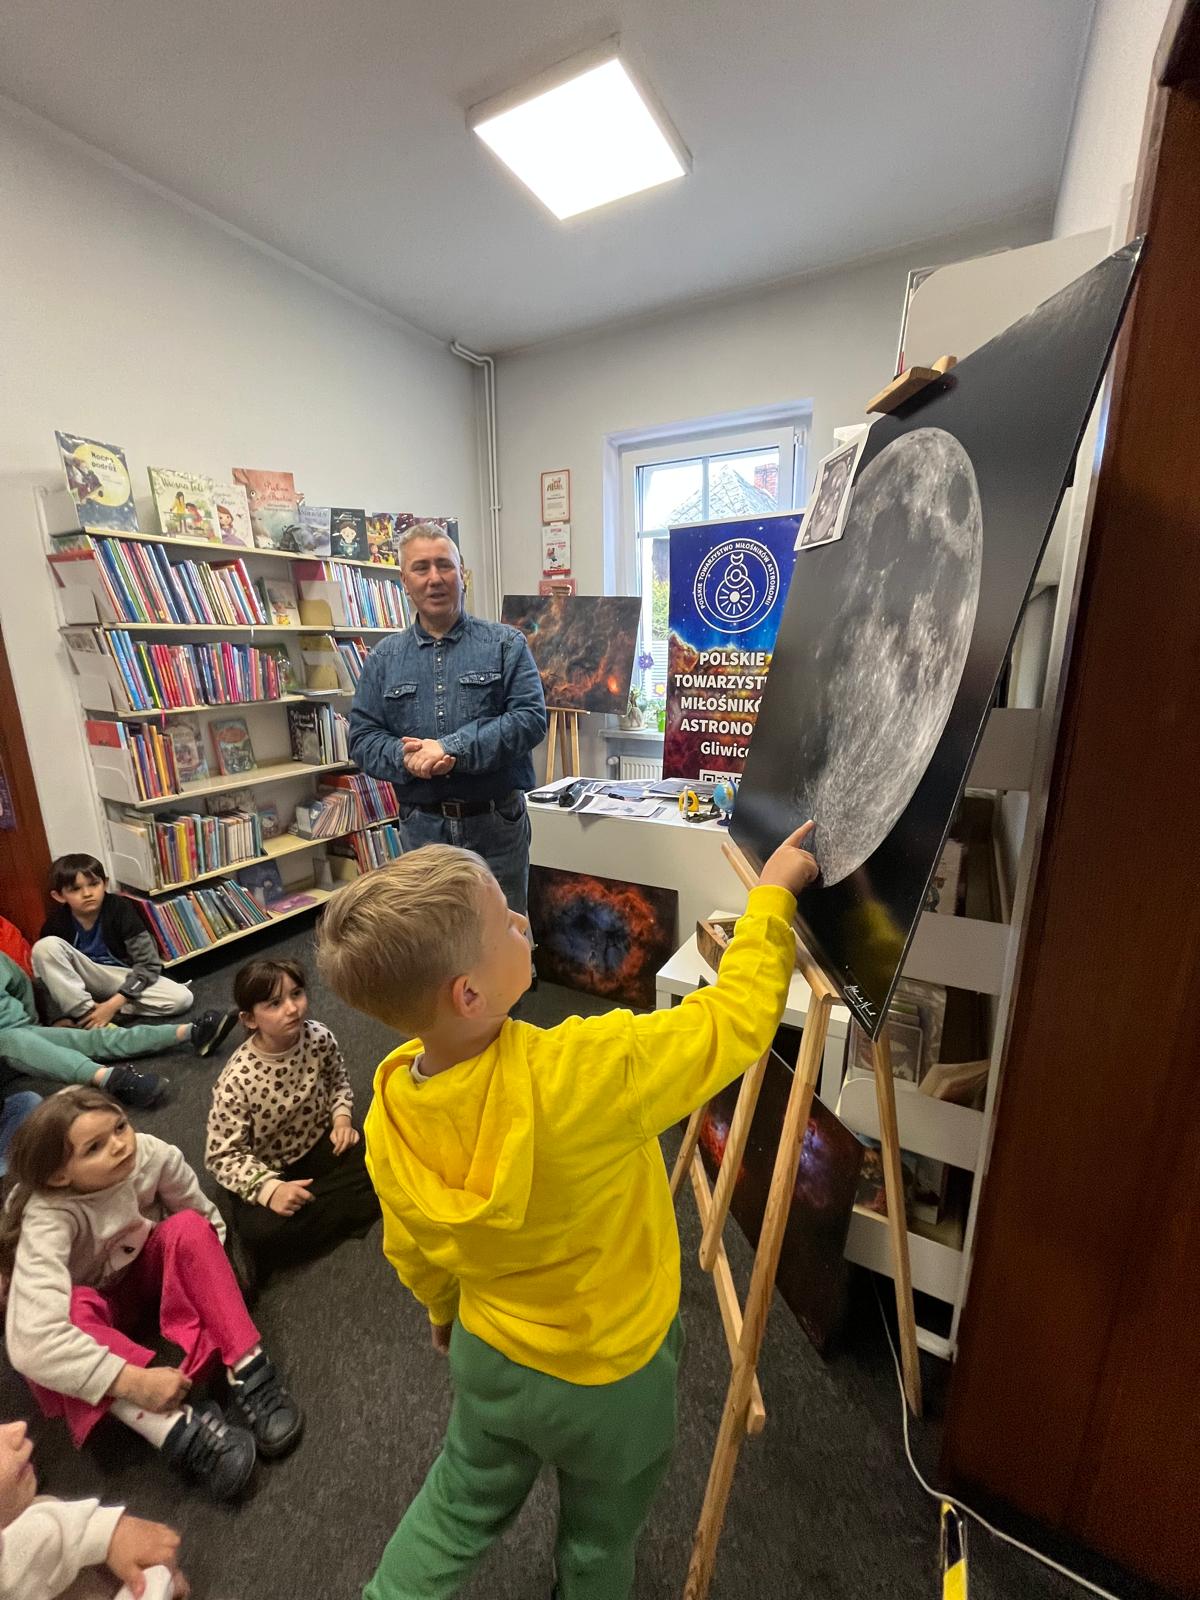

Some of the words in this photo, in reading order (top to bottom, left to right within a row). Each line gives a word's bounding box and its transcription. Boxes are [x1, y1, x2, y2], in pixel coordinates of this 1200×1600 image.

[735, 541, 770, 563] MIŁOŚNIKÓW
[699, 544, 734, 581] TOWARZYSTWO
[764, 563, 776, 606] ASTRONOMII
[697, 583, 706, 609] POLSKIE
[699, 652, 766, 667] POLSKIE
[674, 674, 768, 690] TOWARZYST
[680, 694, 763, 713] MIŁOŚNIKÓ
[680, 718, 754, 736] ASTRONO
